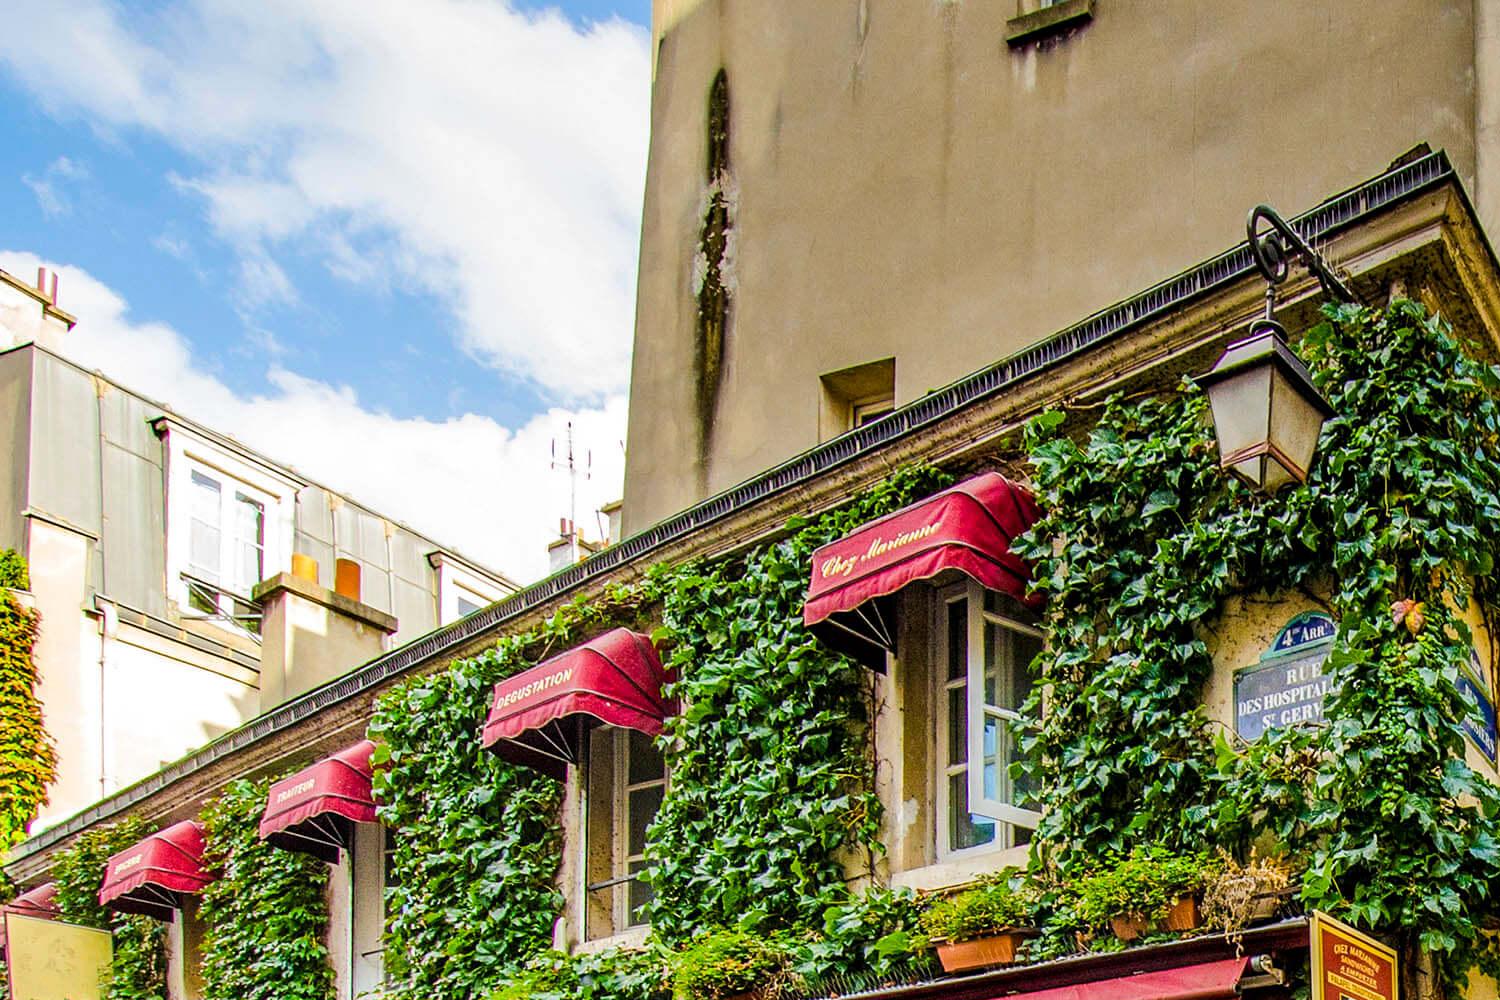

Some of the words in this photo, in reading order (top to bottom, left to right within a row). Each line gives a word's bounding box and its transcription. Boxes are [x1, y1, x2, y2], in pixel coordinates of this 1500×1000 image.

[821, 555, 857, 577] Chez
[1286, 662, 1321, 685] RUE
[496, 668, 573, 710] DEGUSTATION
[1238, 697, 1262, 716] DES
[1281, 700, 1324, 725] GERV
